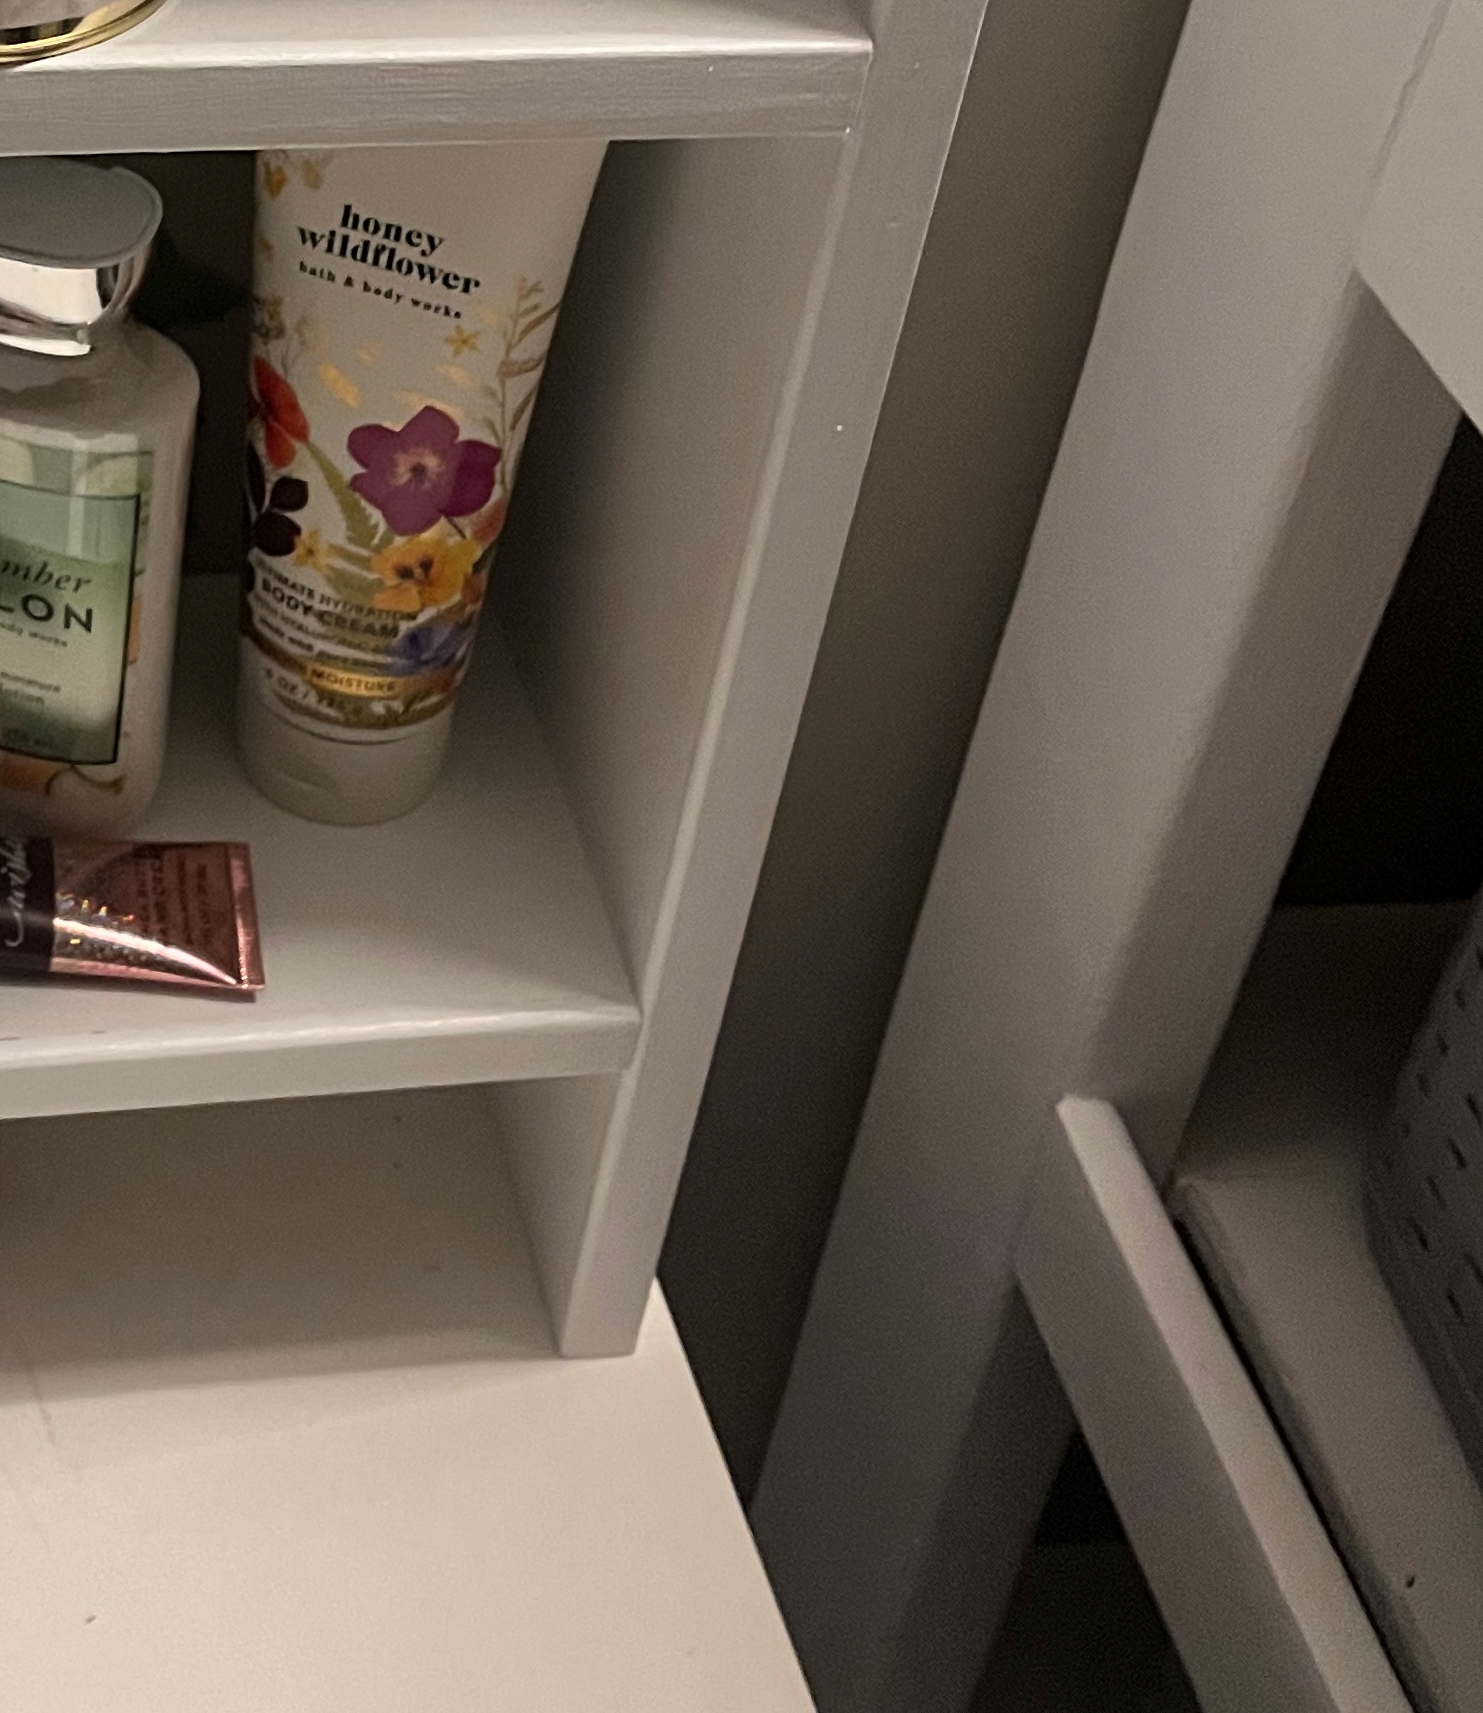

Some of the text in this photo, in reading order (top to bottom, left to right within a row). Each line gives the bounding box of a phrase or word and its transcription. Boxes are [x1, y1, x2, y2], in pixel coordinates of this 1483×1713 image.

[295, 224, 482, 296] wildflower
[339, 202, 446, 258] honey
[298, 259, 337, 284] bath
[361, 279, 405, 306] body
[409, 296, 463, 321] works
[261, 576, 314, 617] BODY
[316, 609, 400, 639] CREAM
[310, 667, 396, 691] MOISTURE
